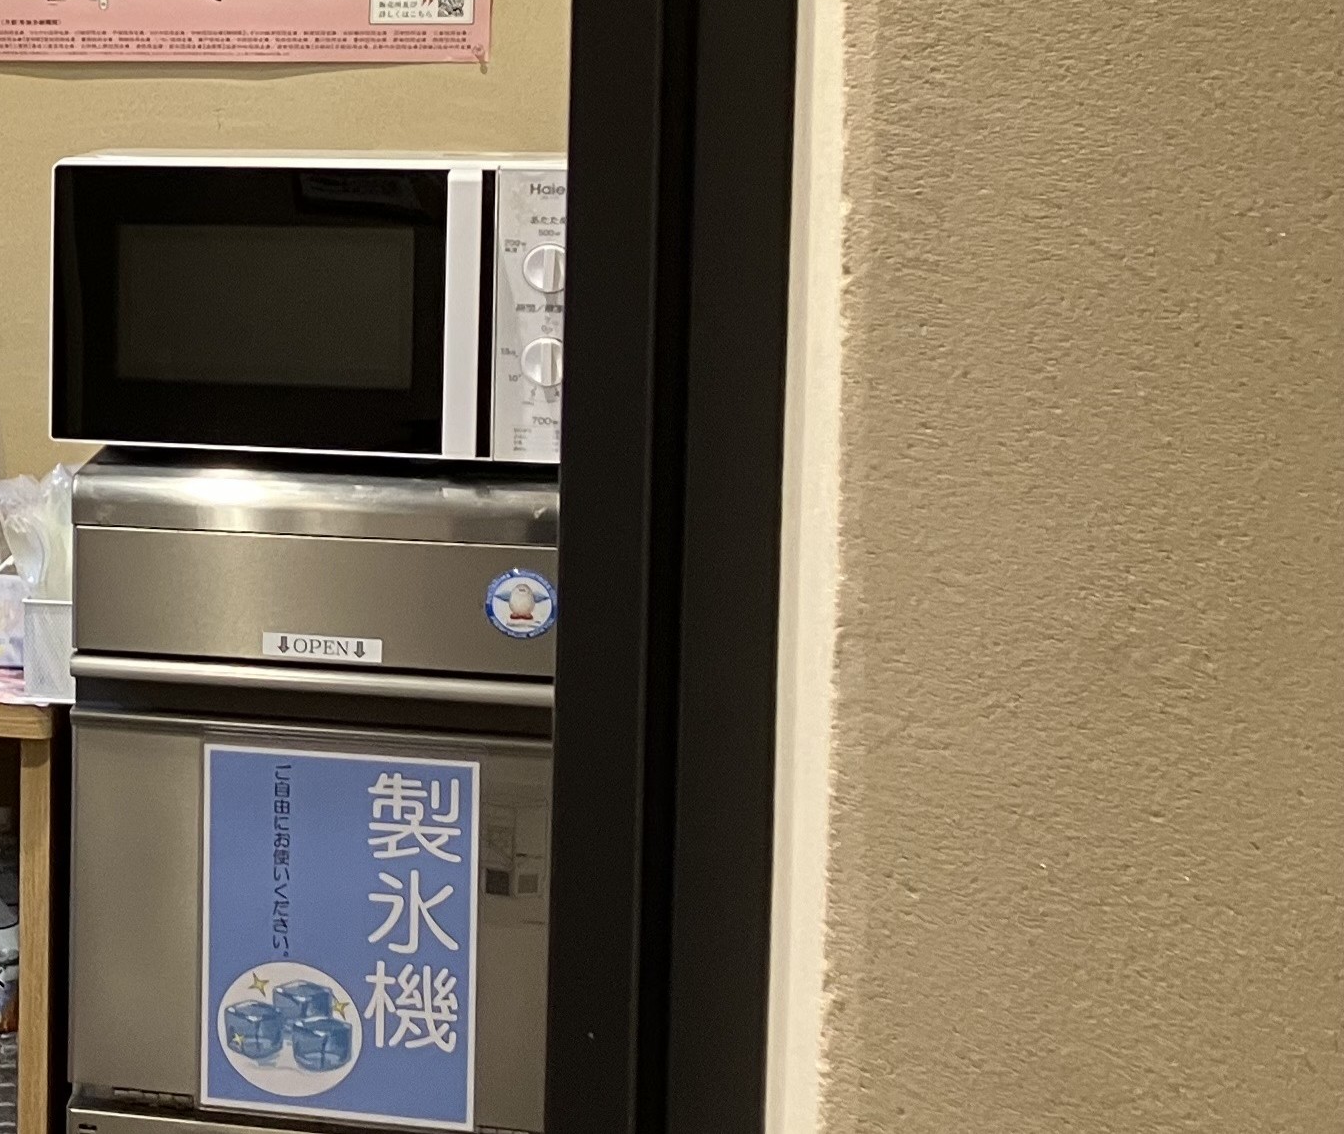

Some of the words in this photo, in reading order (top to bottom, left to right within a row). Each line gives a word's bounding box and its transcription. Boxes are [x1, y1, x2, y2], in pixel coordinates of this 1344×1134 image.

[293, 638, 350, 657] OPEN
[272, 763, 292, 958] ご自由にお使いください。
[365, 772, 463, 1054] 製氷機
